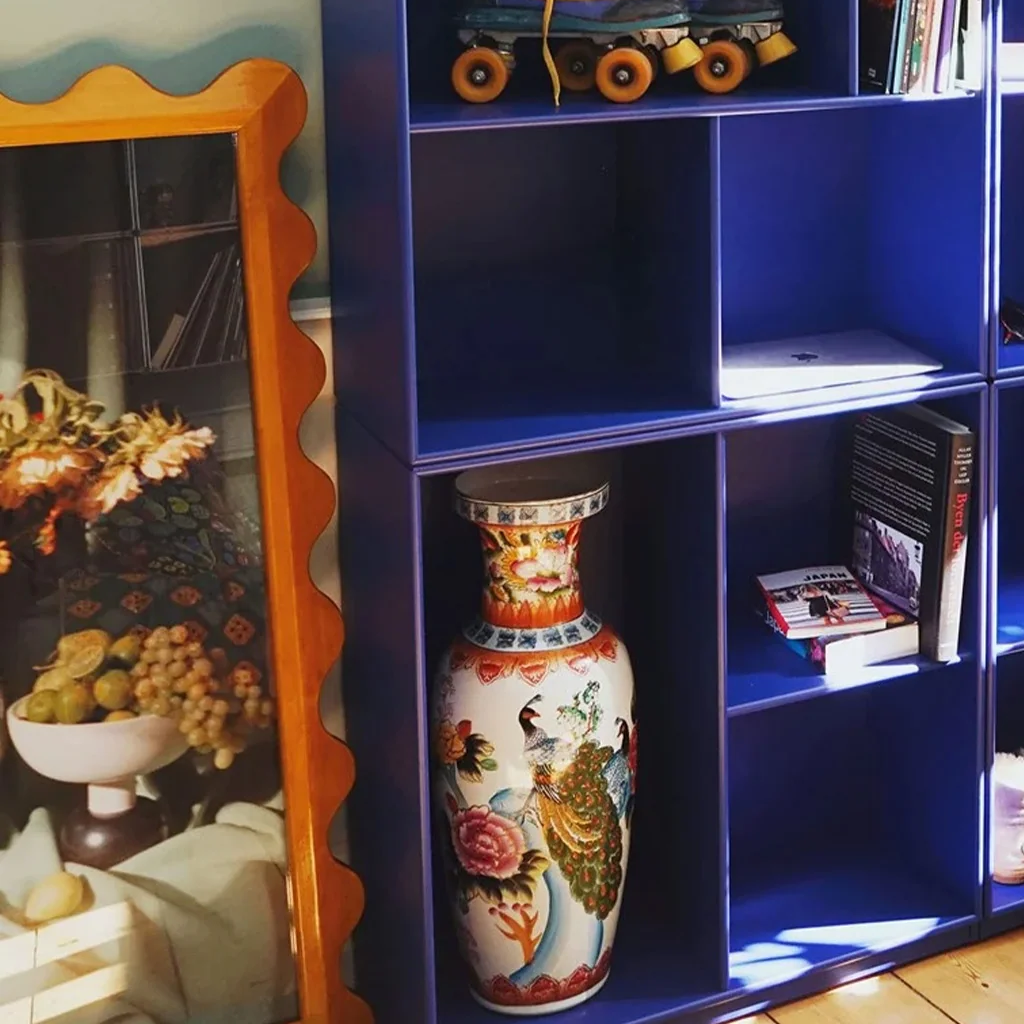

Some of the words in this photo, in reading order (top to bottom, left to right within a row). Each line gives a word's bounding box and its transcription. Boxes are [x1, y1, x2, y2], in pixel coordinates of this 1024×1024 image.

[955, 492, 968, 527] Byen
[951, 530, 965, 553] der
[802, 571, 848, 583] JAPAN
